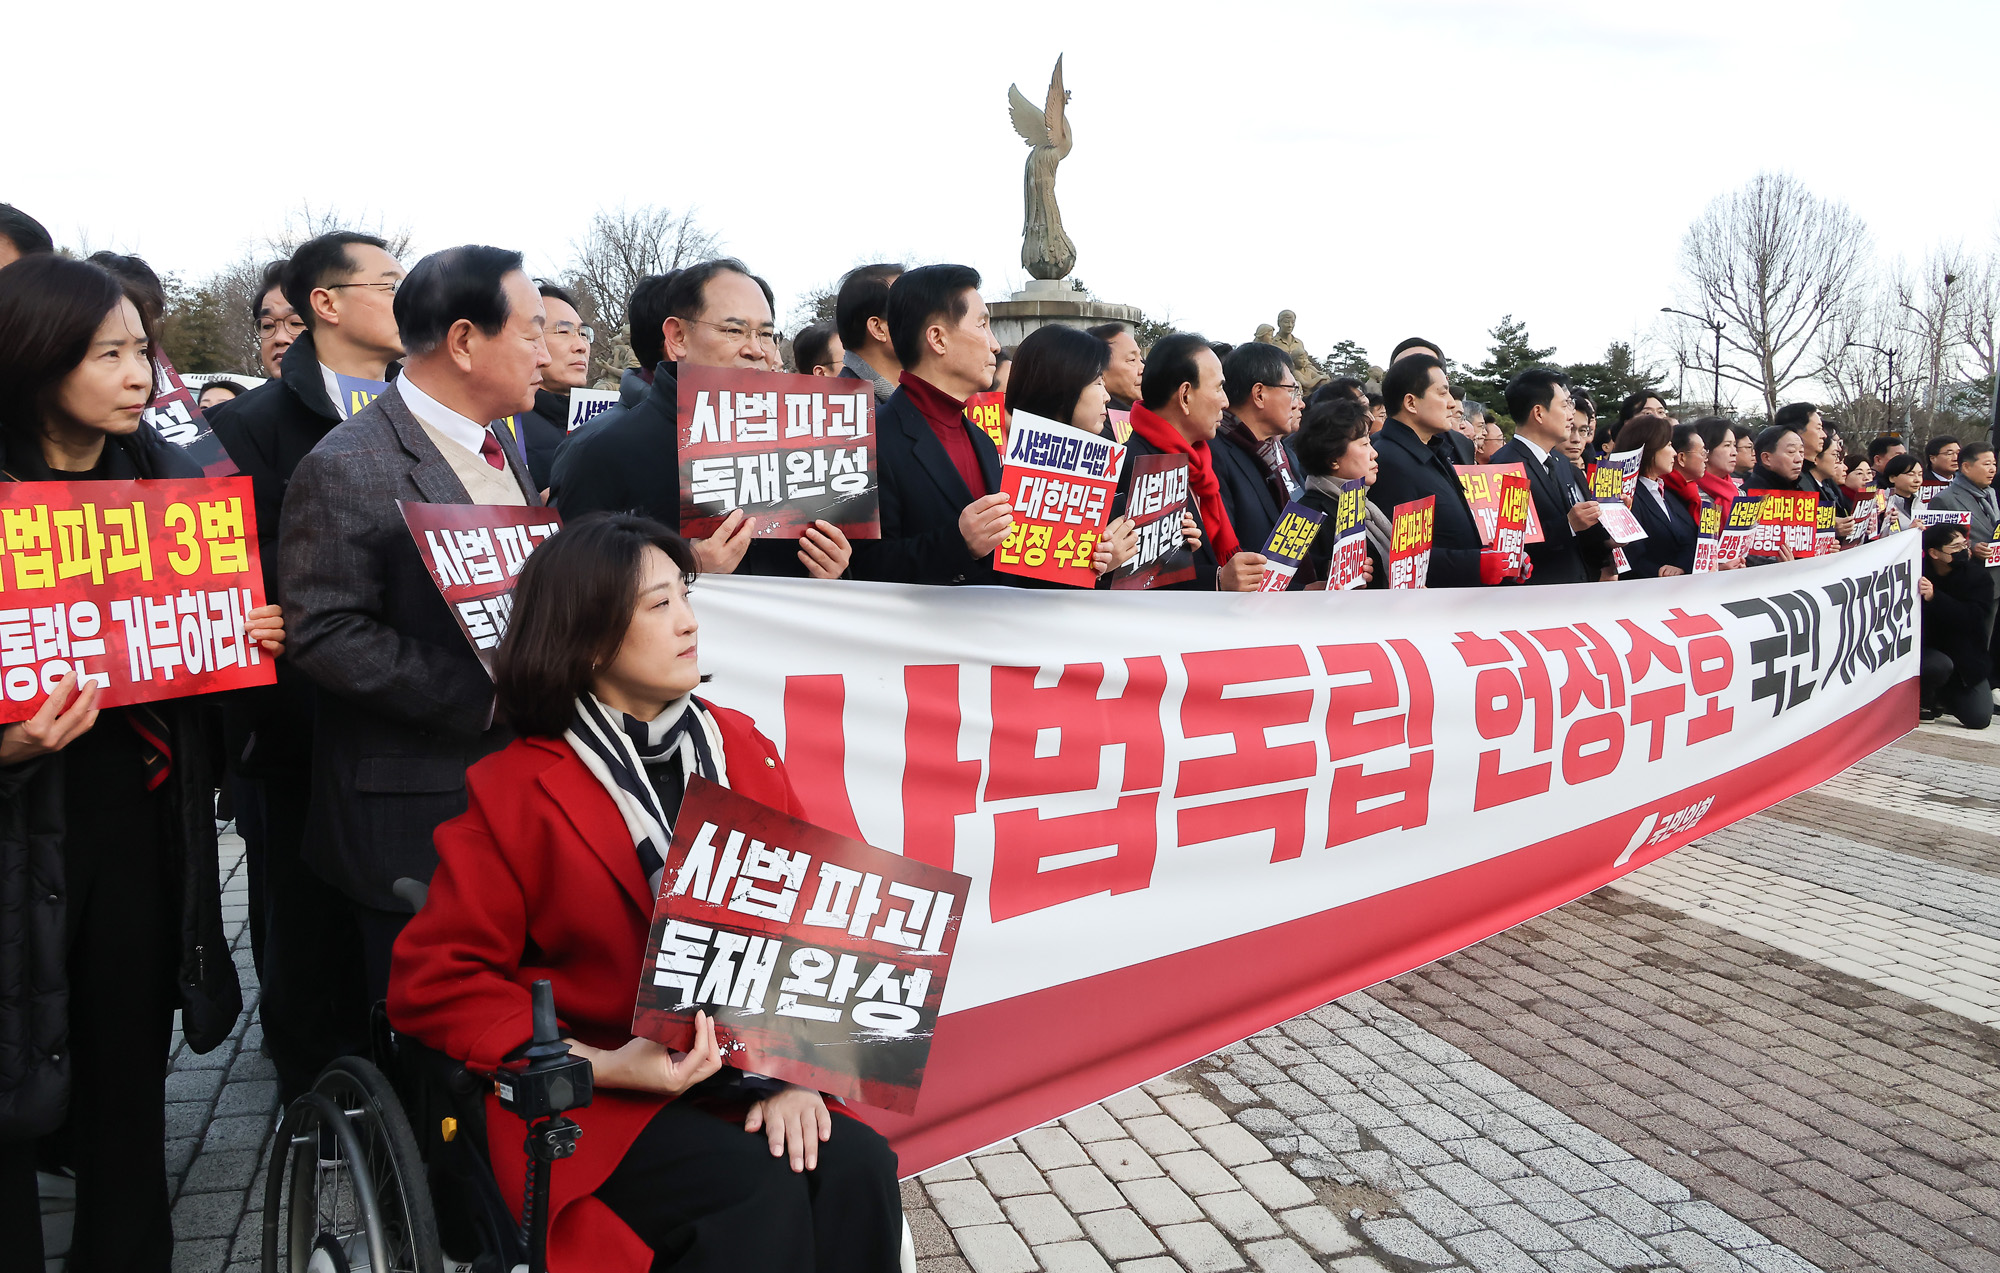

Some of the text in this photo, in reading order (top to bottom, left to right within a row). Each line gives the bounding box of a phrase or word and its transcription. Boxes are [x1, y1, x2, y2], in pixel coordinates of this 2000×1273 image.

[689, 390, 870, 443] 사법 파괴
[1010, 428, 1083, 473] 사법파괴
[1080, 442, 1109, 478] 악법
[691, 446, 870, 513] 독재 완성
[1013, 476, 1107, 527] 대한민국
[1128, 464, 1190, 519] 사법 파괴
[1391, 510, 1422, 554] 사법파괴
[1423, 505, 1433, 544] 3법
[1500, 486, 1530, 525] 사법파
[1763, 495, 1795, 522] 법파괴
[1796, 497, 1816, 522] 3법
[1816, 505, 1833, 529] 권분립
[0, 496, 250, 592] 법파괴 3법
[423, 527, 504, 587] 사법
[1000, 520, 1103, 569] 헌정 수호
[1267, 512, 1322, 561] 삼권분립
[1717, 535, 1741, 560] 당장
[1752, 524, 1782, 552] 통령은
[1783, 524, 1814, 552] 거부하라!
[0, 587, 261, 703] 통령은 거부하라!
[1451, 607, 1734, 812] 헌정수호
[1720, 589, 1820, 718] 국민
[1821, 561, 1914, 691] 기자회견
[1646, 794, 1716, 846] 국민의힘
[668, 820, 955, 956] 사법 파괴
[652, 917, 933, 1031] 독재 완성
